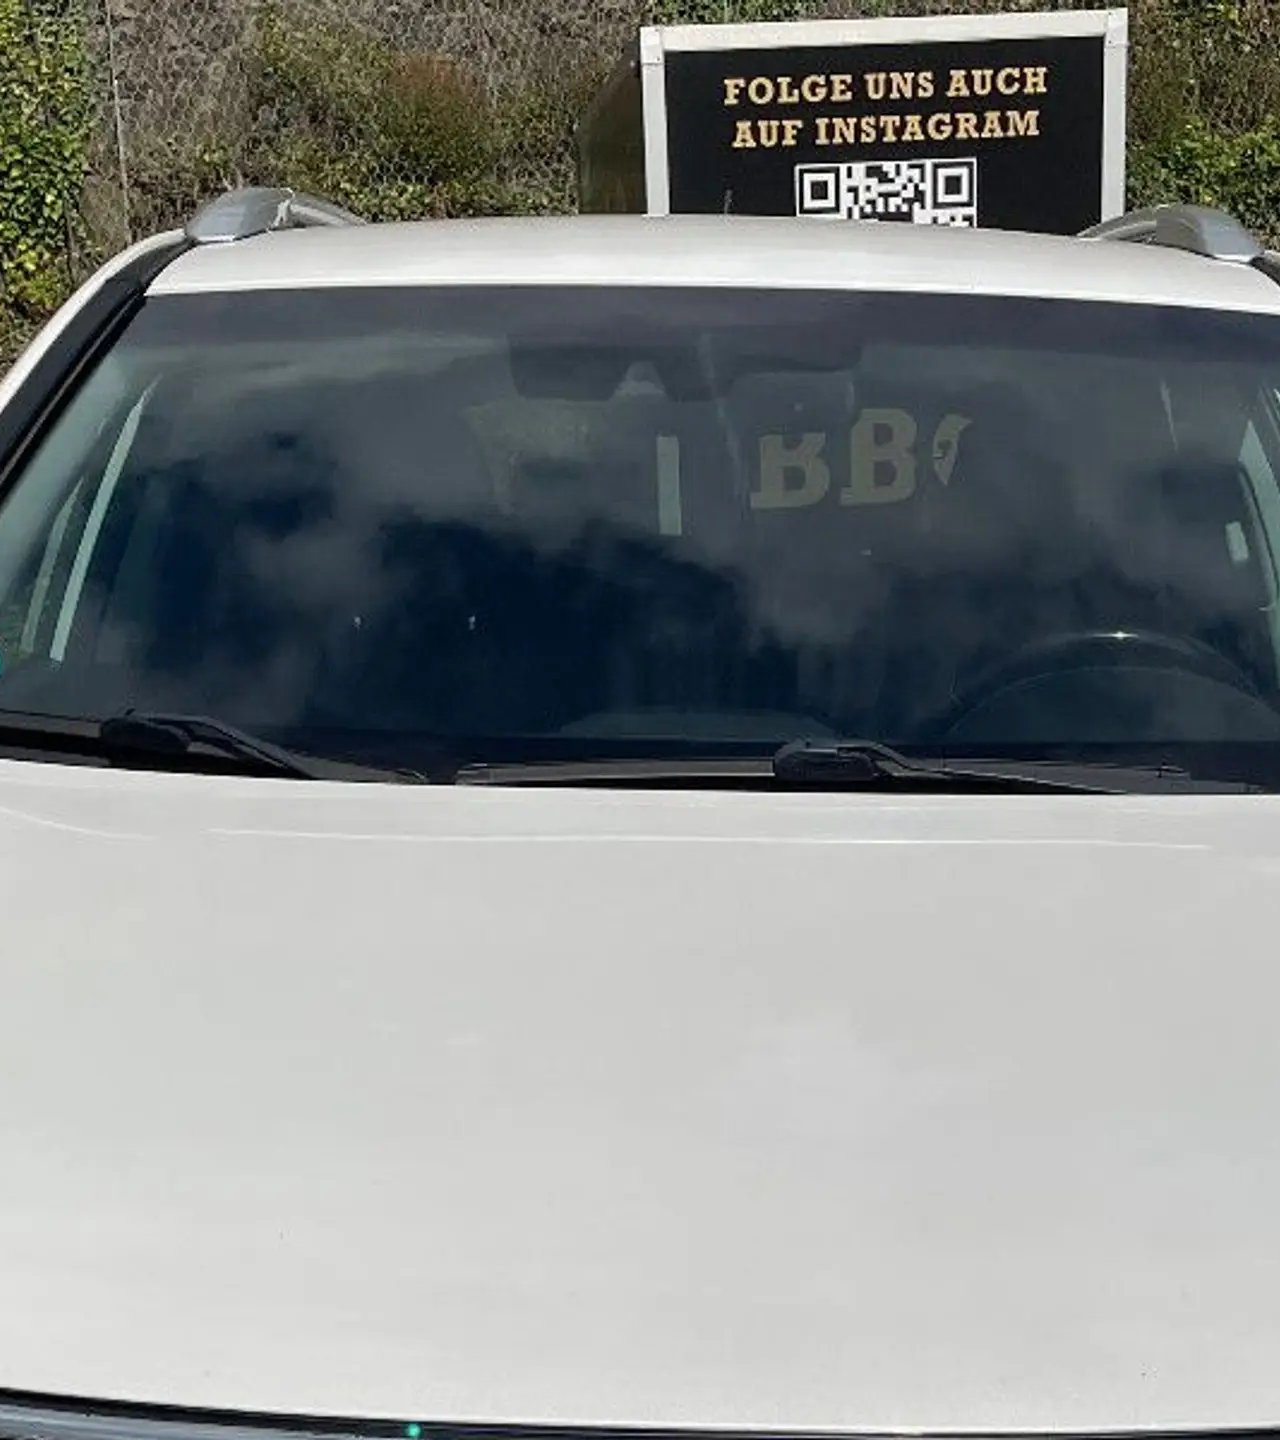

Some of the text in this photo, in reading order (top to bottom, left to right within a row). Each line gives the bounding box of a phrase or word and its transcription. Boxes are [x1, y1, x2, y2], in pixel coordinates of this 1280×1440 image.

[723, 67, 1048, 106] FOLGE UNS AUCH
[731, 109, 1040, 149] AUF INSTAGRAM
